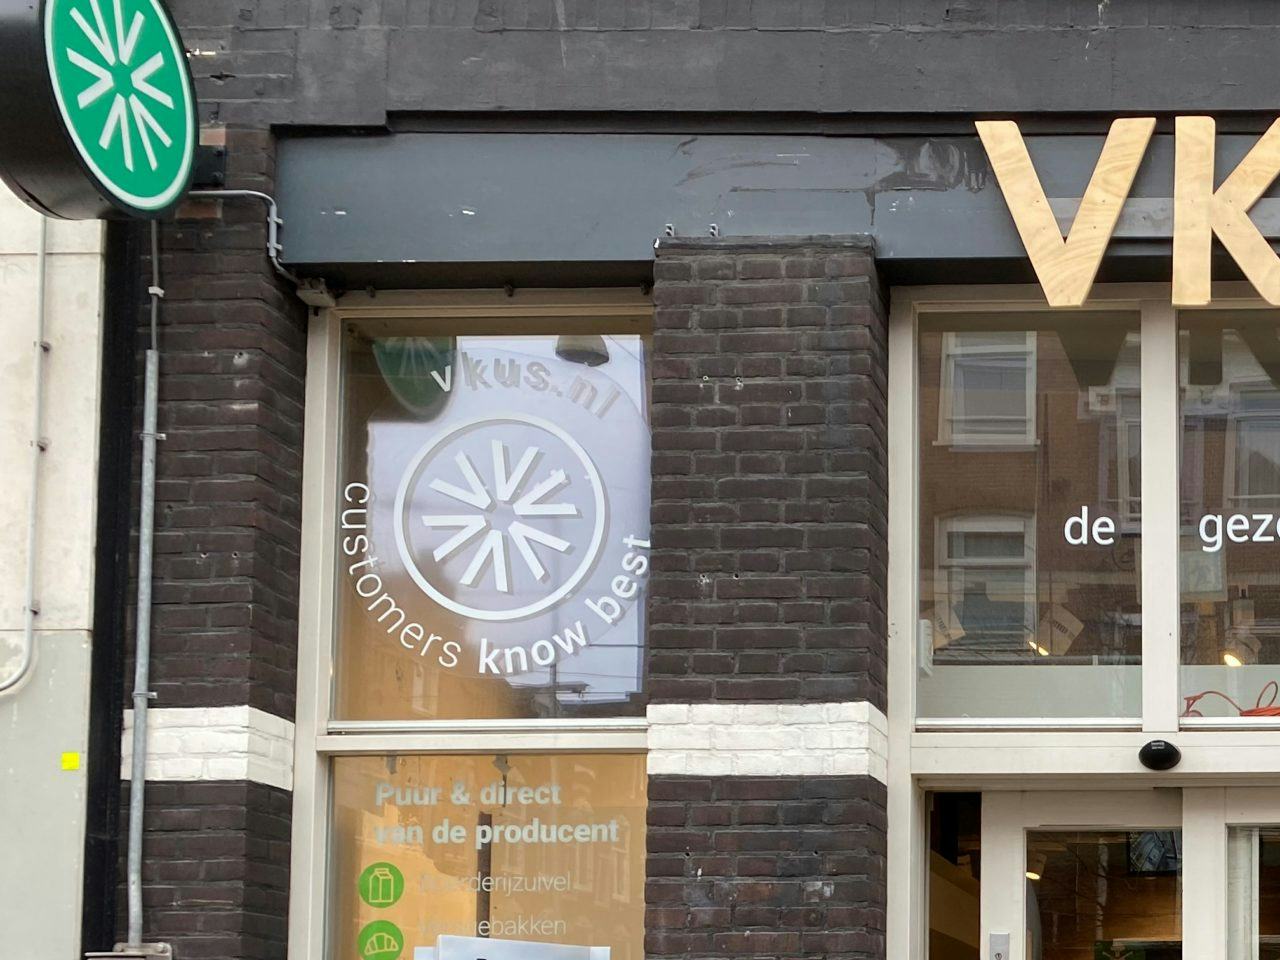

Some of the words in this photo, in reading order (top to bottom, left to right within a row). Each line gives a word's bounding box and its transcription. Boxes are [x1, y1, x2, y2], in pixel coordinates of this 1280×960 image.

[430, 351, 621, 418] vkus.nl
[1063, 506, 1115, 546] de
[341, 482, 461, 668] customers
[478, 621, 588, 675] know
[585, 534, 650, 626] best
[375, 783, 442, 806] Puur
[451, 781, 470, 805] &
[480, 782, 562, 805] direct
[374, 824, 423, 845] van
[432, 818, 466, 844] de
[476, 818, 619, 850] producent
